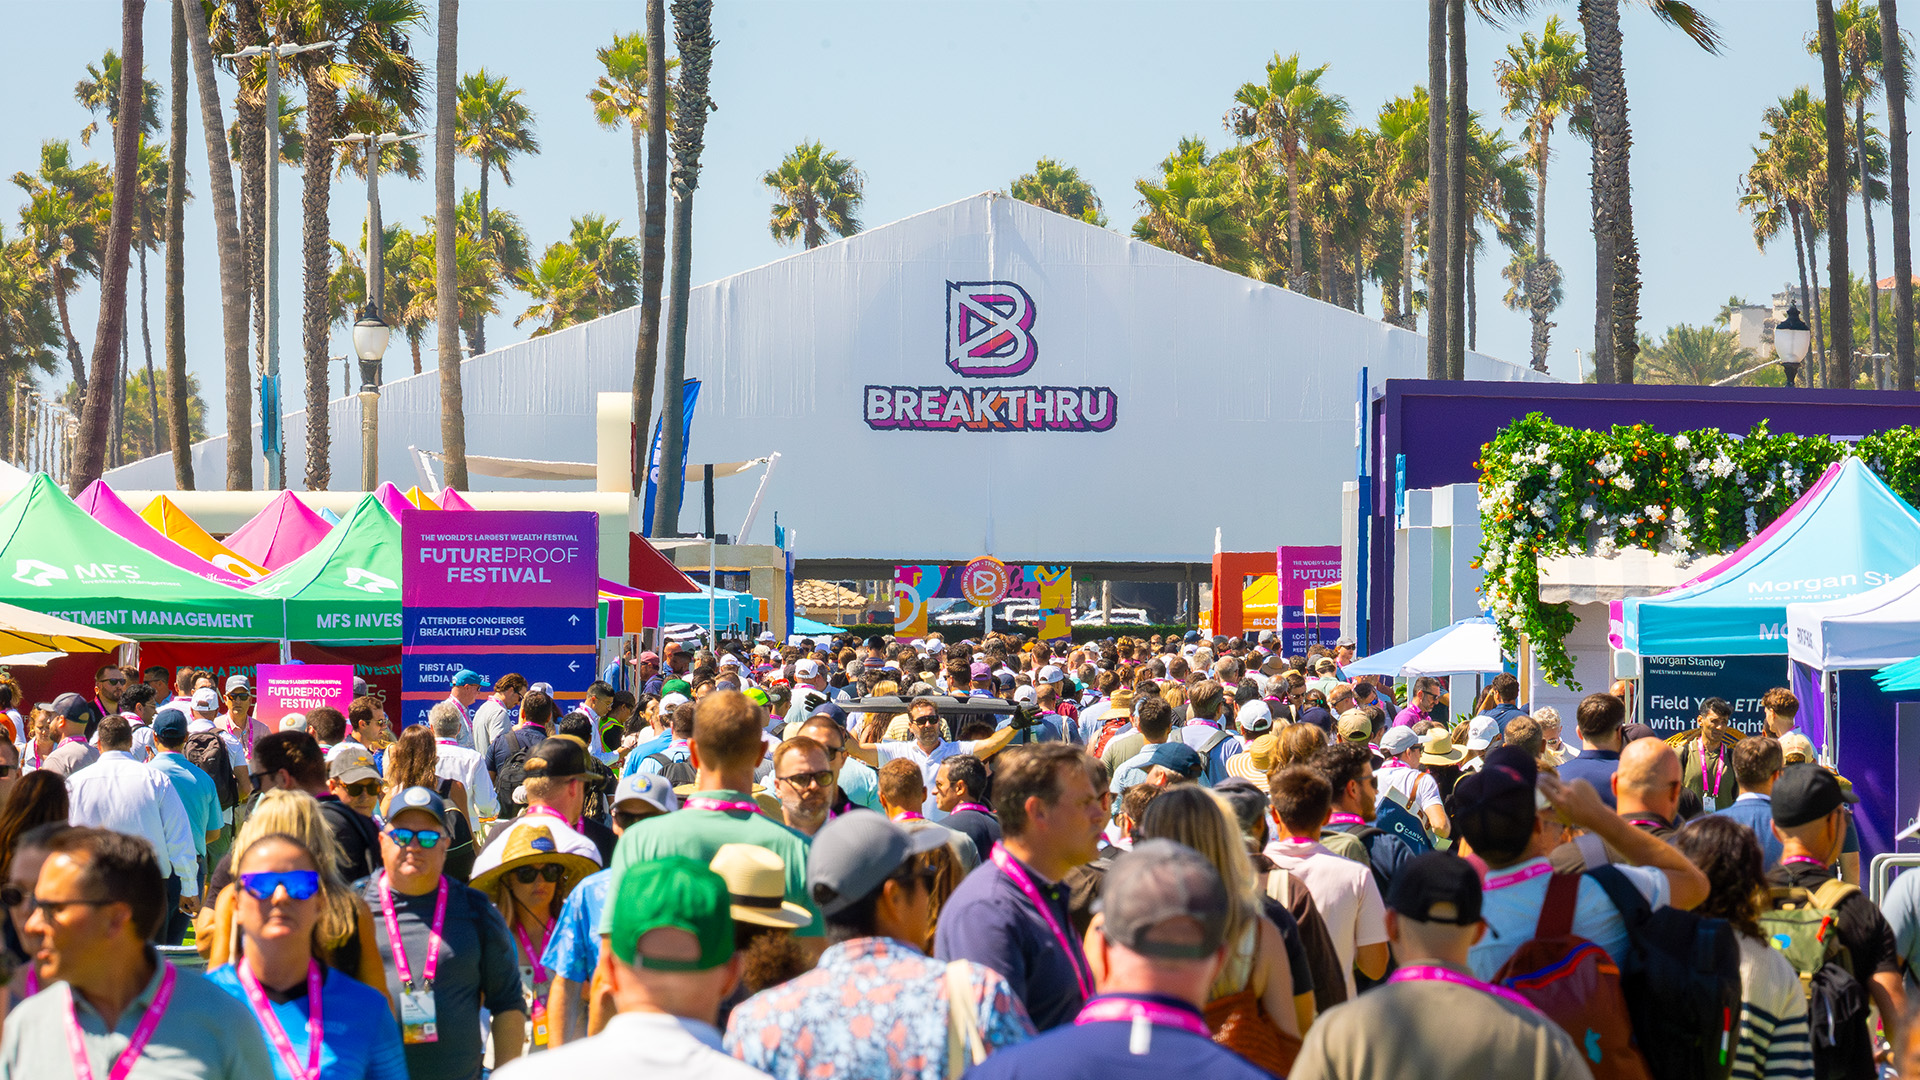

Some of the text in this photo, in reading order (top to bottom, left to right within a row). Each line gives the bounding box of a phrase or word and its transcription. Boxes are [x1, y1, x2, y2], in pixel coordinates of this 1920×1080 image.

[865, 386, 1116, 430] BREAKTHRU
[447, 567, 551, 583] FESTIVAL
[1748, 573, 1857, 594] Morgan
[132, 610, 253, 628] MANAGEMENT
[317, 614, 351, 628] MFS
[420, 616, 524, 625] ATTENDEE CONCIERGE
[420, 628, 527, 636] BREAKTHRU HELP DESK
[419, 663, 464, 671] FIRST AID
[1649, 656, 1726, 669] Morgan Stanley
[217, 666, 226, 677] A
[419, 674, 450, 683] MEDIA
[1651, 695, 1689, 710] Field
[1650, 715, 1685, 730] with
